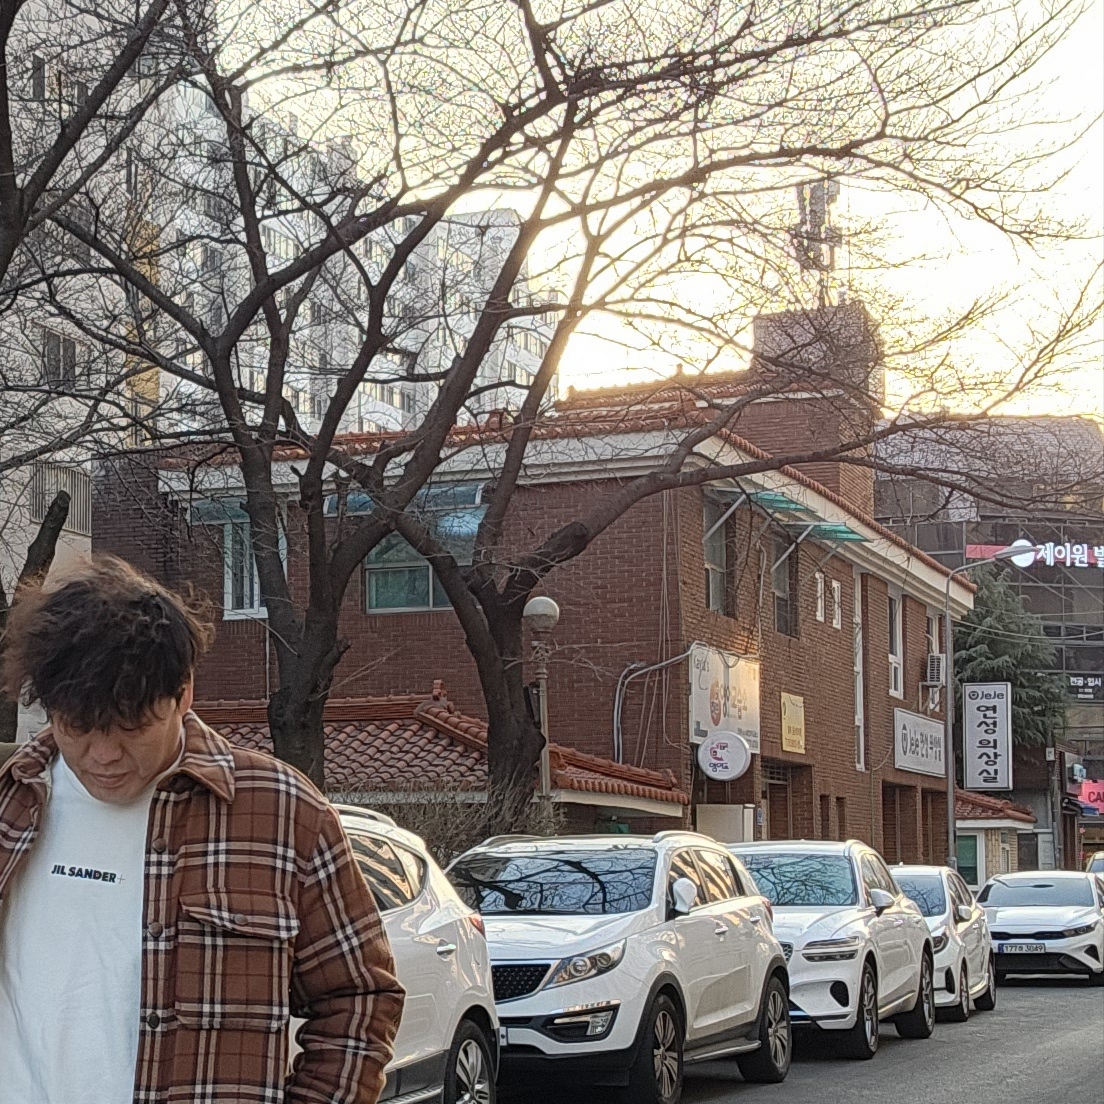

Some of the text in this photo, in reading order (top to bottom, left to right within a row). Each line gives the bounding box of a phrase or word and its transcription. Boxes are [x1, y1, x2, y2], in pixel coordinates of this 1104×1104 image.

[1036, 542, 1088, 567] 제이원
[1087, 791, 1104, 803] CA
[51, 864, 67, 876] JIL
